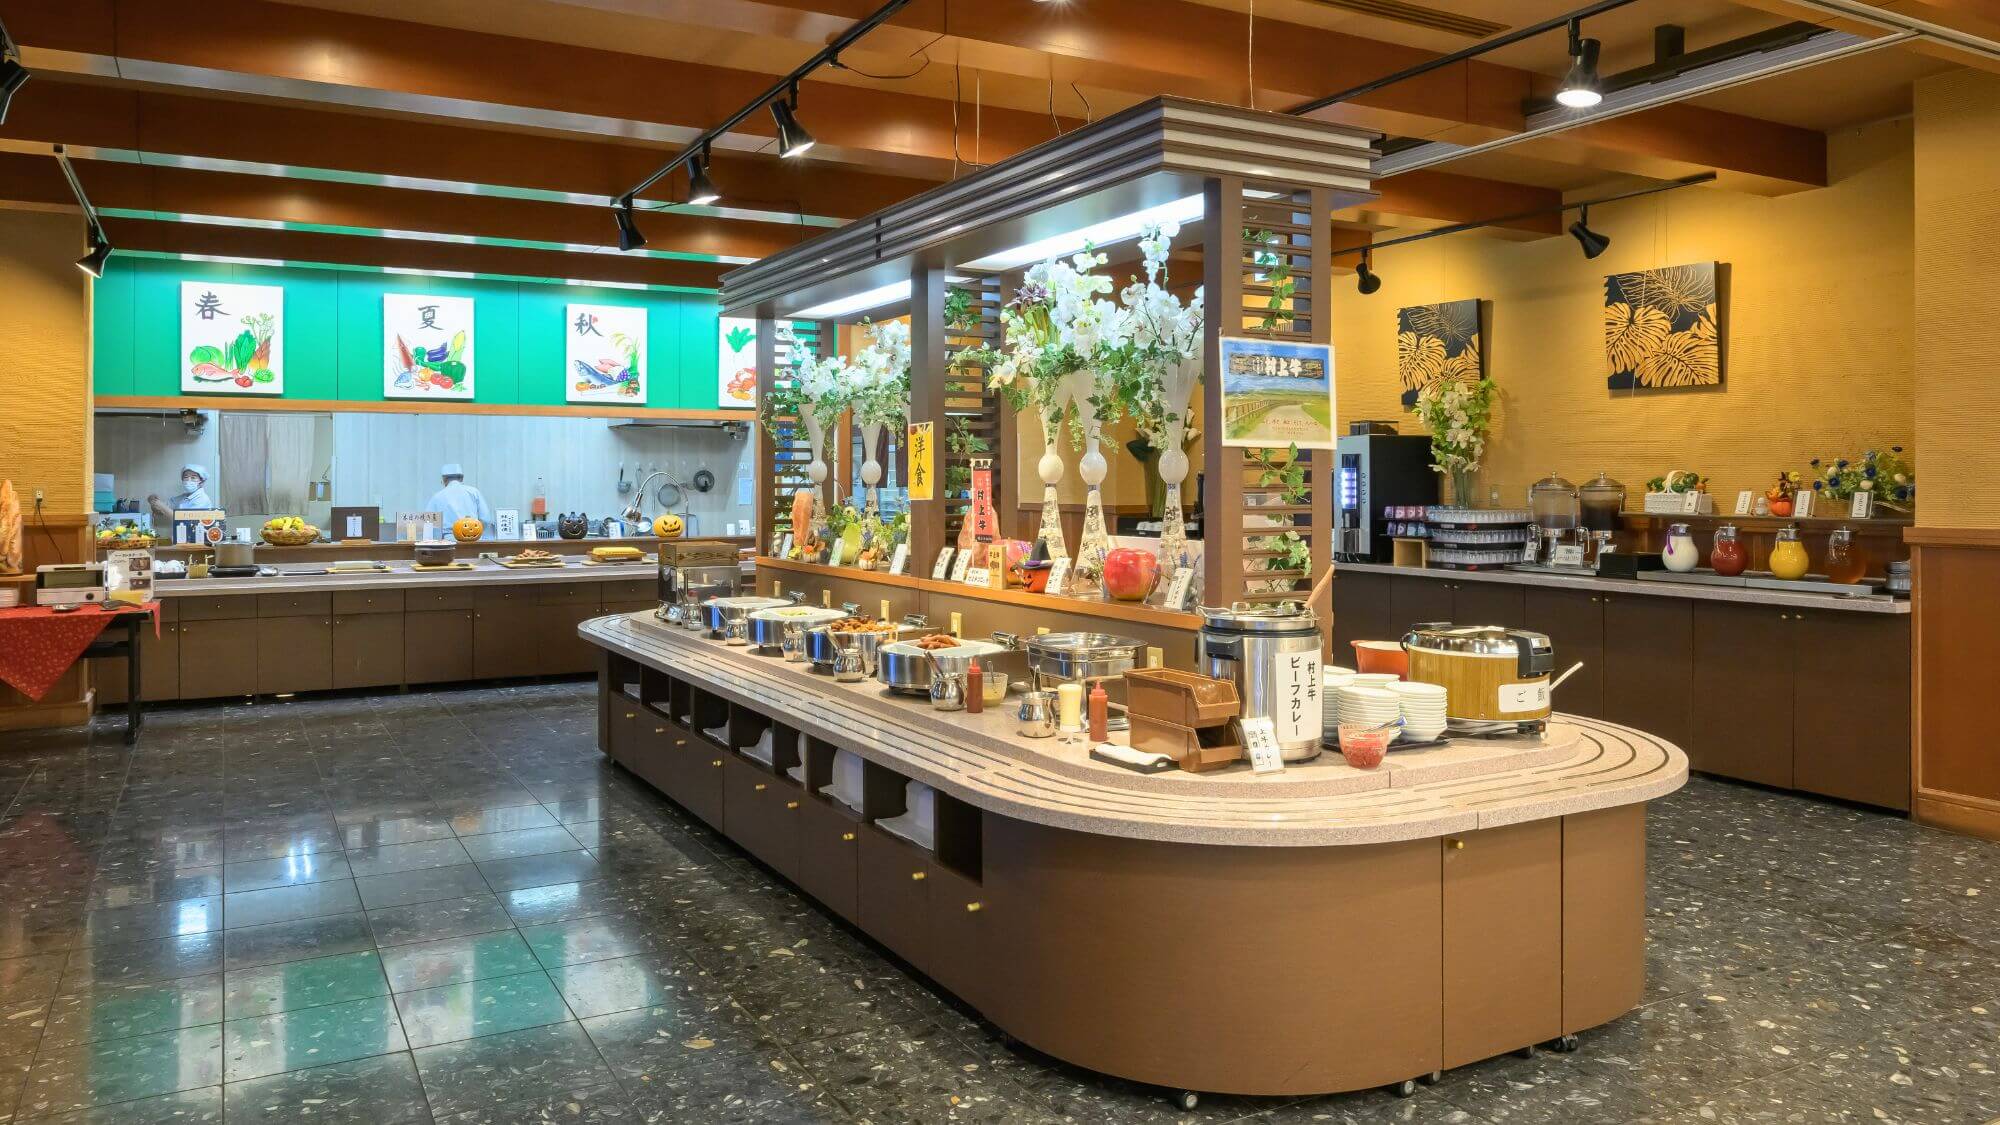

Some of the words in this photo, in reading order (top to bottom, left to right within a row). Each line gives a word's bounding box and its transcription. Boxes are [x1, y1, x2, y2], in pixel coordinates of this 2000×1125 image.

[195, 291, 231, 320] 春
[417, 305, 445, 330] 夏
[574, 312, 604, 337] 秋
[1264, 356, 1303, 378] 村上牛
[914, 435, 926, 487] 洋食
[1307, 660, 1317, 701] 村上牛
[1290, 656, 1302, 736] ビーフカレー
